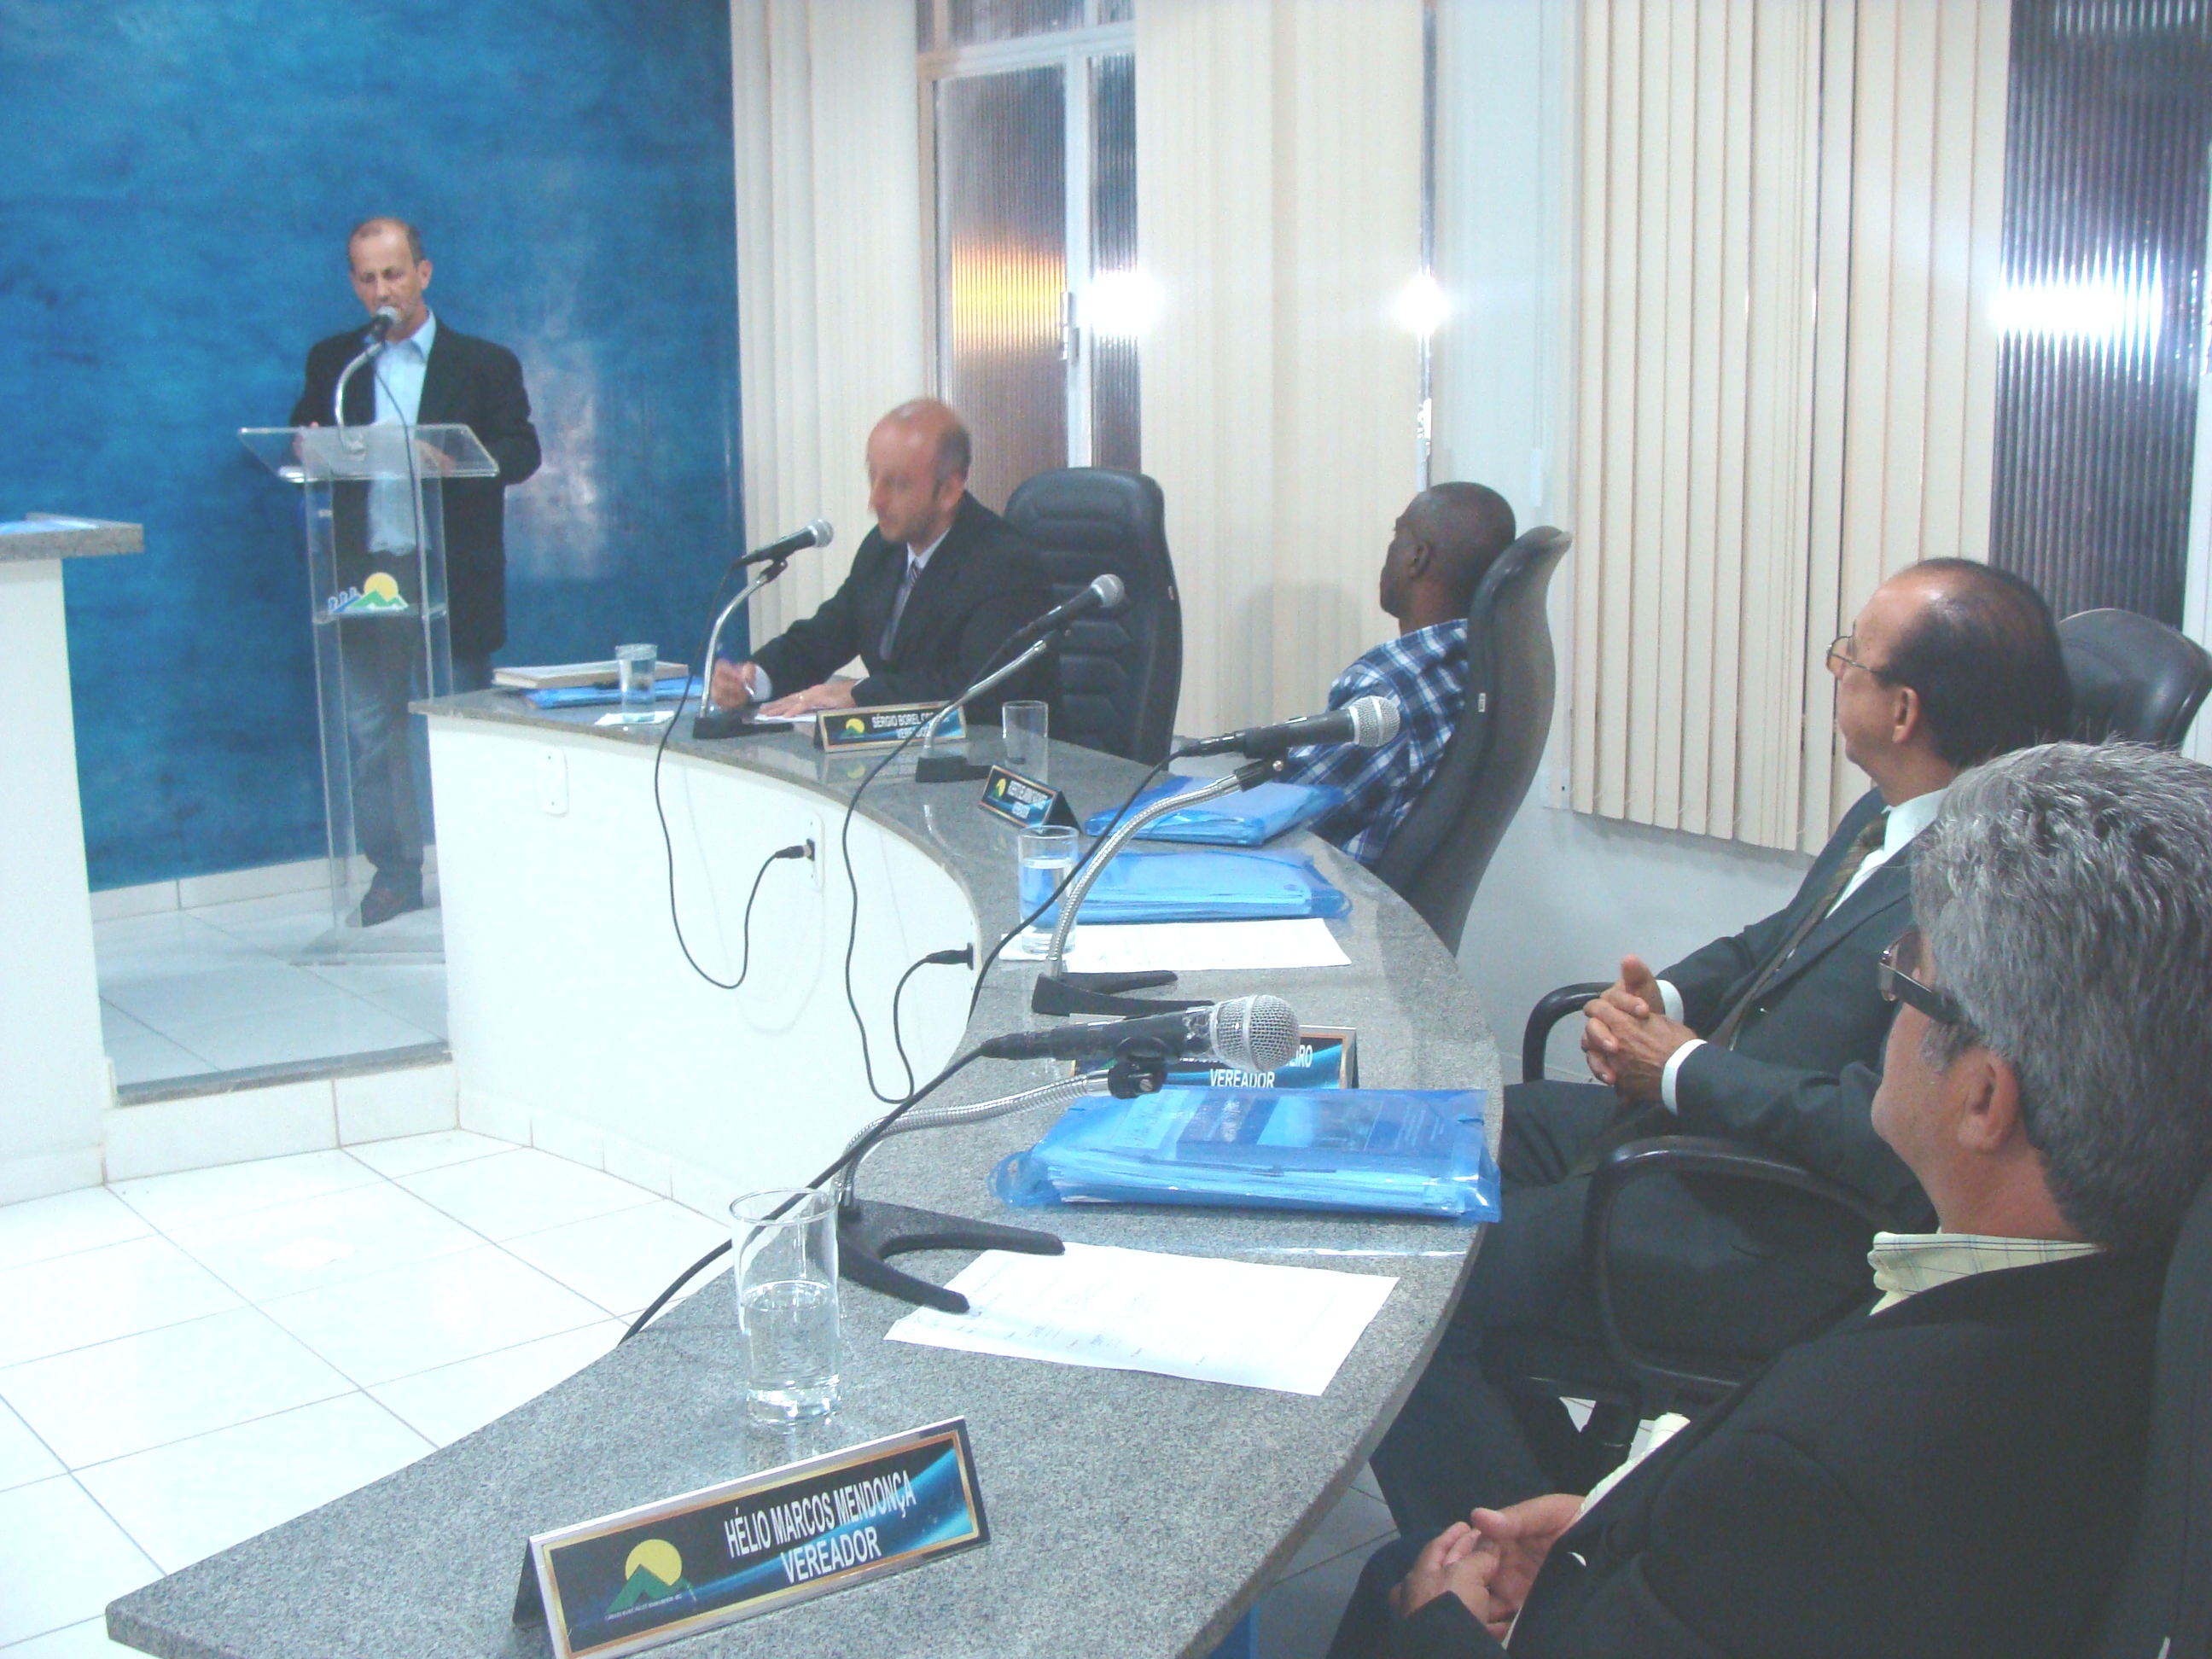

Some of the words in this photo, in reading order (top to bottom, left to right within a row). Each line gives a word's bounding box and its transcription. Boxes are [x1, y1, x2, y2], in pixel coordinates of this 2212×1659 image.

[871, 713, 898, 729] SÉRGIO
[1210, 1068, 1275, 1088] VEREADOR
[725, 1506, 771, 1558] HÉLIO
[771, 1492, 835, 1545] MARCOS
[833, 1470, 917, 1518] MENDONÇA
[781, 1526, 882, 1584] VEREADOR
